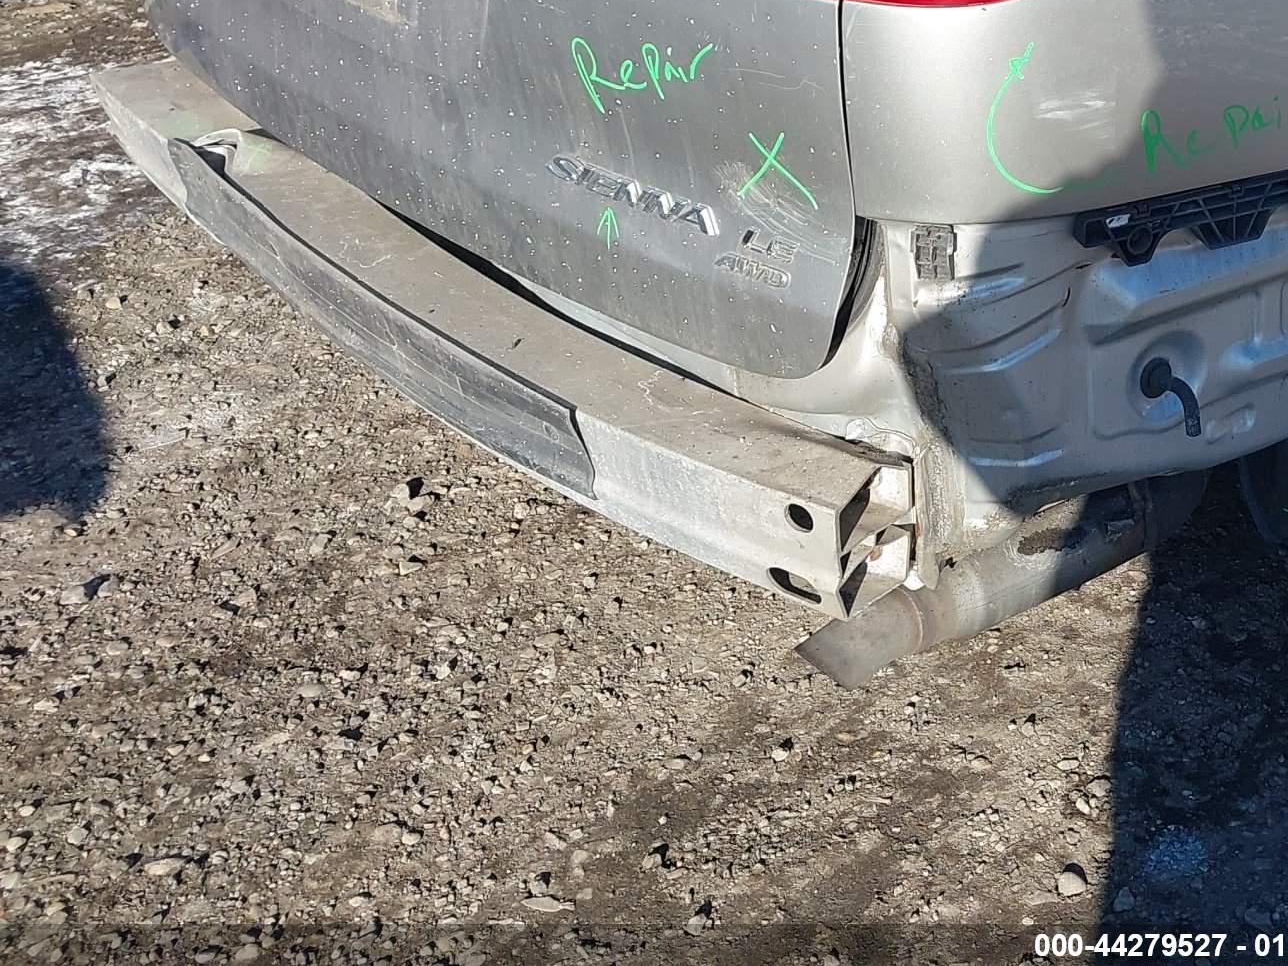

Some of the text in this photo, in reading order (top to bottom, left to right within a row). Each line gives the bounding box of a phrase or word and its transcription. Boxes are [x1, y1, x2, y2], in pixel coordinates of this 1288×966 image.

[546, 153, 720, 236] SIENNA
[741, 226, 802, 264] LE
[713, 251, 793, 289] AWD
